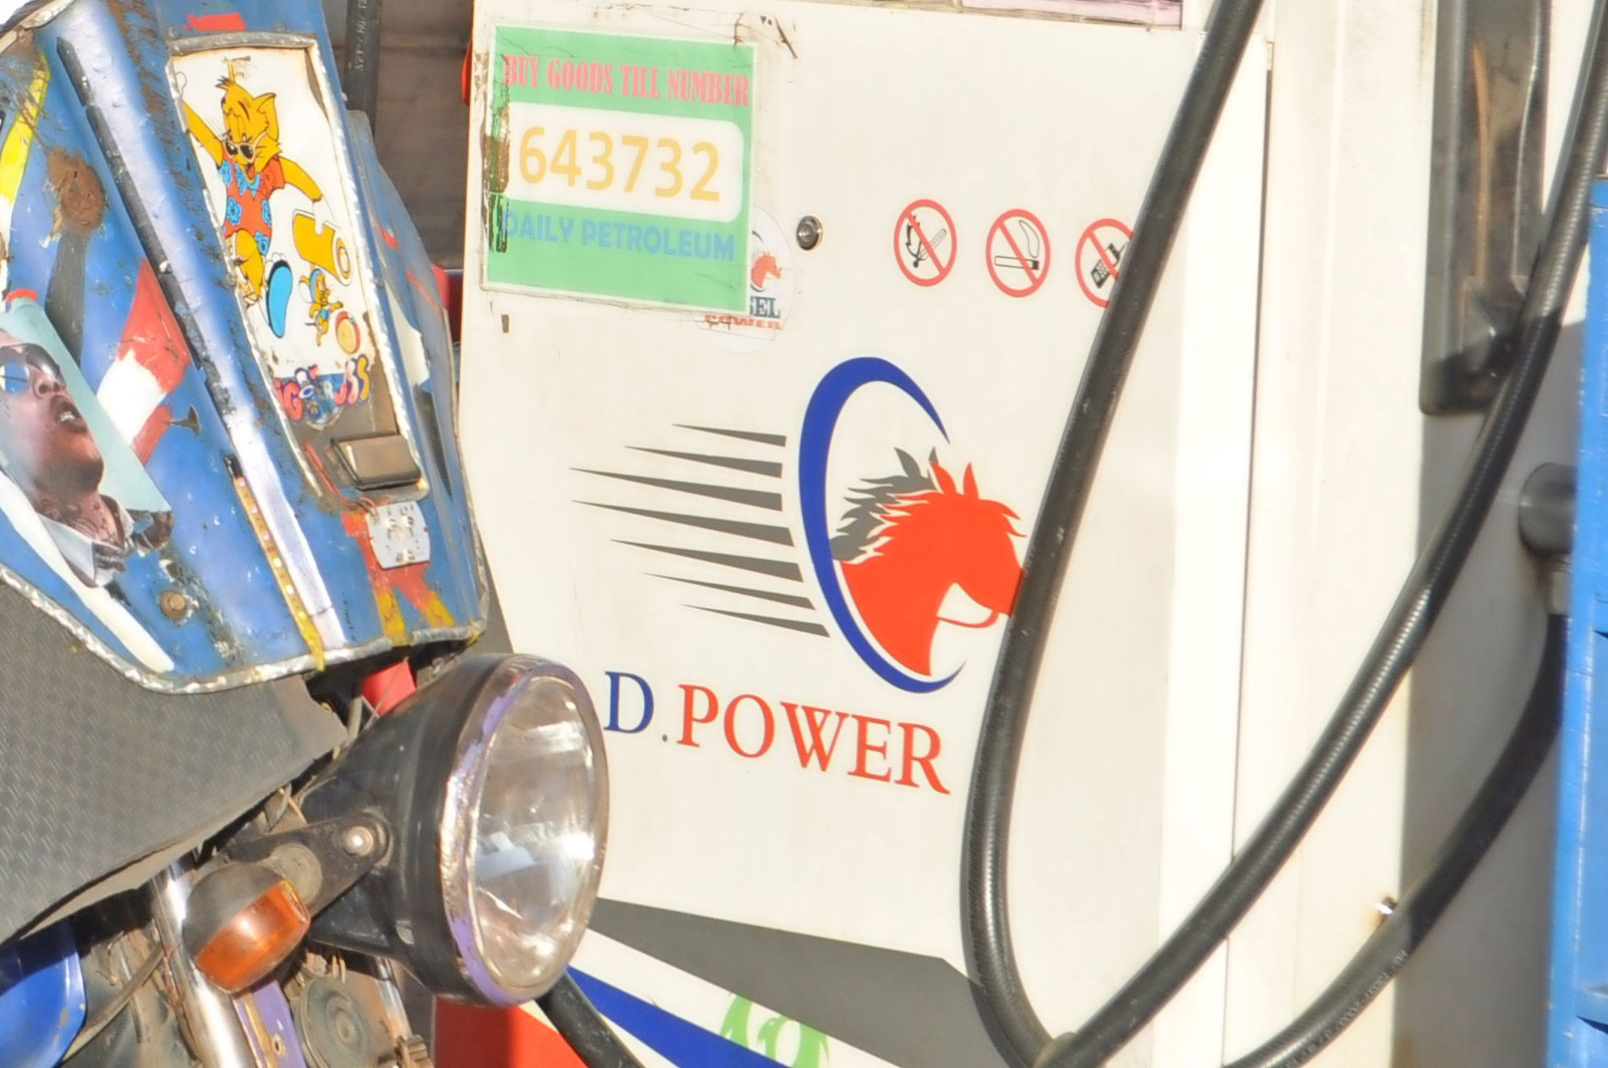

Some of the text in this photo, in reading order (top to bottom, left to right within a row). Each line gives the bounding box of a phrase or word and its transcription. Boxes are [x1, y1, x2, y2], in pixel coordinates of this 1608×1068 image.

[503, 53, 750, 107] BUY GOODS TILL NUMBER
[518, 126, 721, 203] 643732
[502, 210, 736, 263] DAILY PETROLEUM
